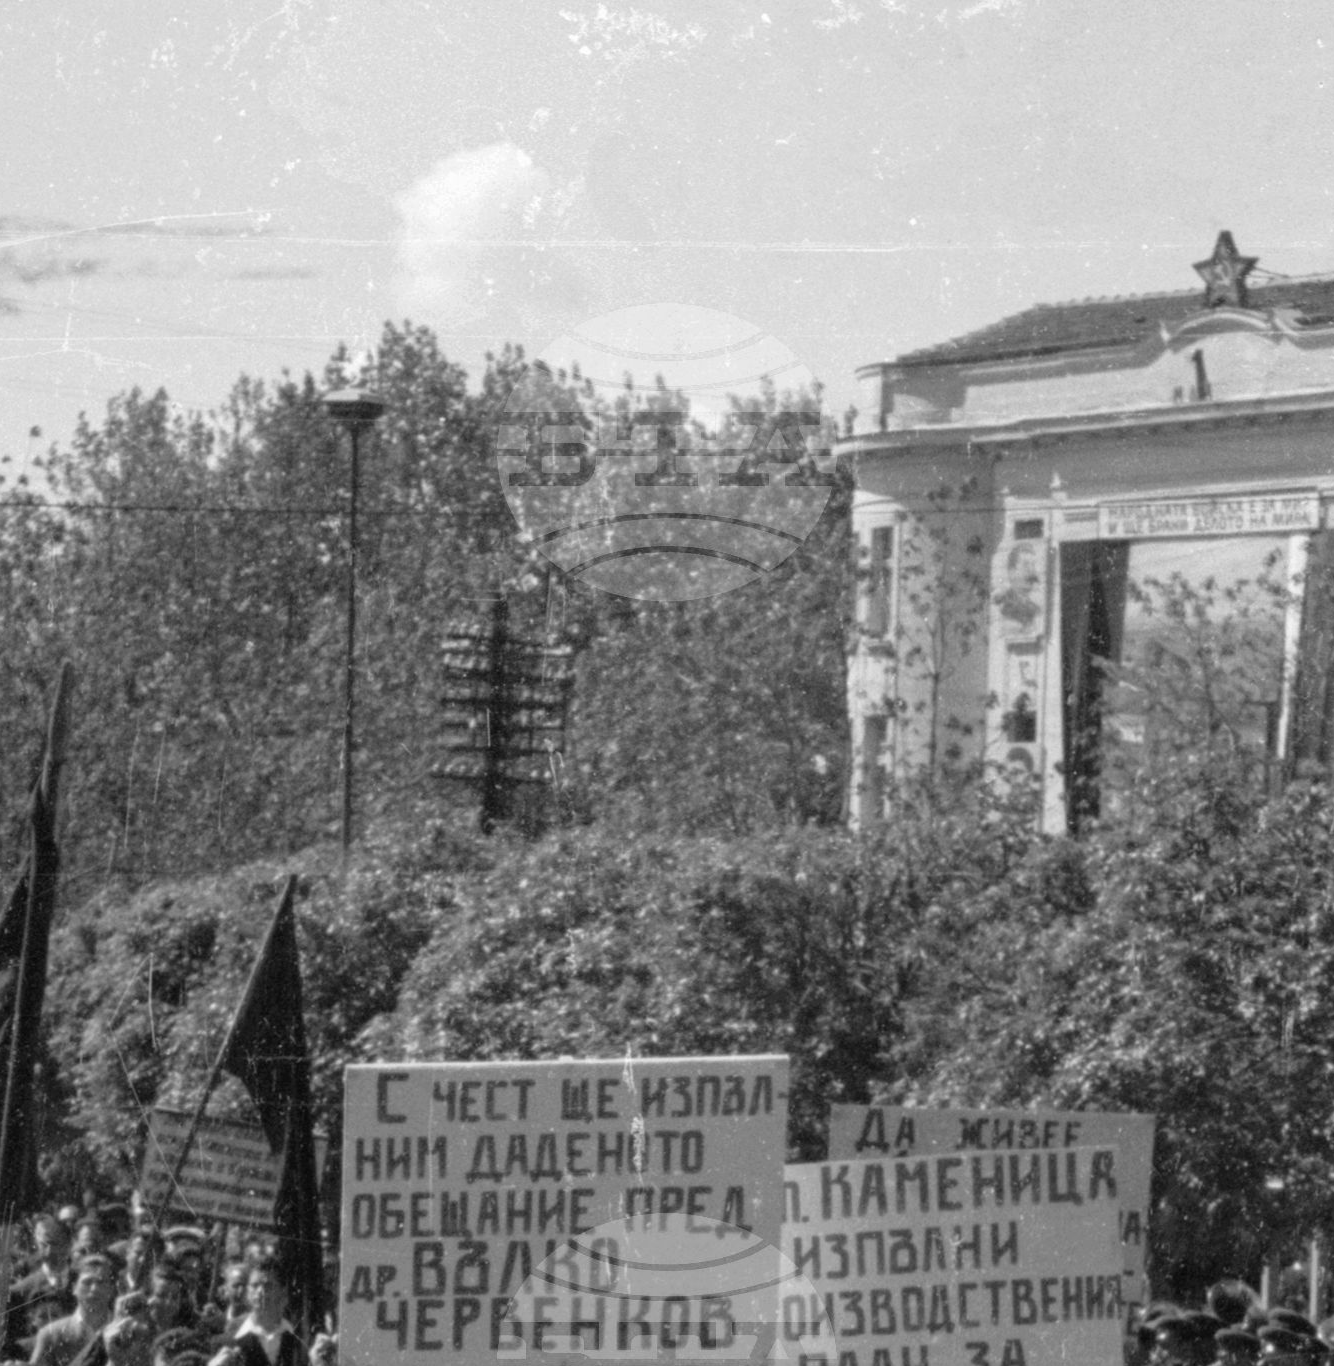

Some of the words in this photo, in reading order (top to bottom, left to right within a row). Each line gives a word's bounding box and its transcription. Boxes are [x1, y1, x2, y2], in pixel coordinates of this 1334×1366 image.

[376, 1072, 409, 1123] С
[432, 1078, 535, 1123] ЧЕСТ
[561, 1077, 620, 1123] ЩЕ
[354, 1135, 447, 1181] НИМ
[466, 1130, 704, 1183] ДАДЕНОТО
[854, 1108, 916, 1153] ДА
[350, 1188, 595, 1239] ОБЕЩАНИЕ
[625, 1186, 753, 1240] ПРЕД
[821, 1151, 1117, 1221] КАМЕНИЦА
[412, 1238, 620, 1297] ВЪЛКО
[793, 1220, 1019, 1281] ИЗПЪЛНИ
[375, 1295, 735, 1351] ЧЕРВЕНКОВ
[782, 1274, 1122, 1342] ОИЗВОДСТВЕНИЯ
